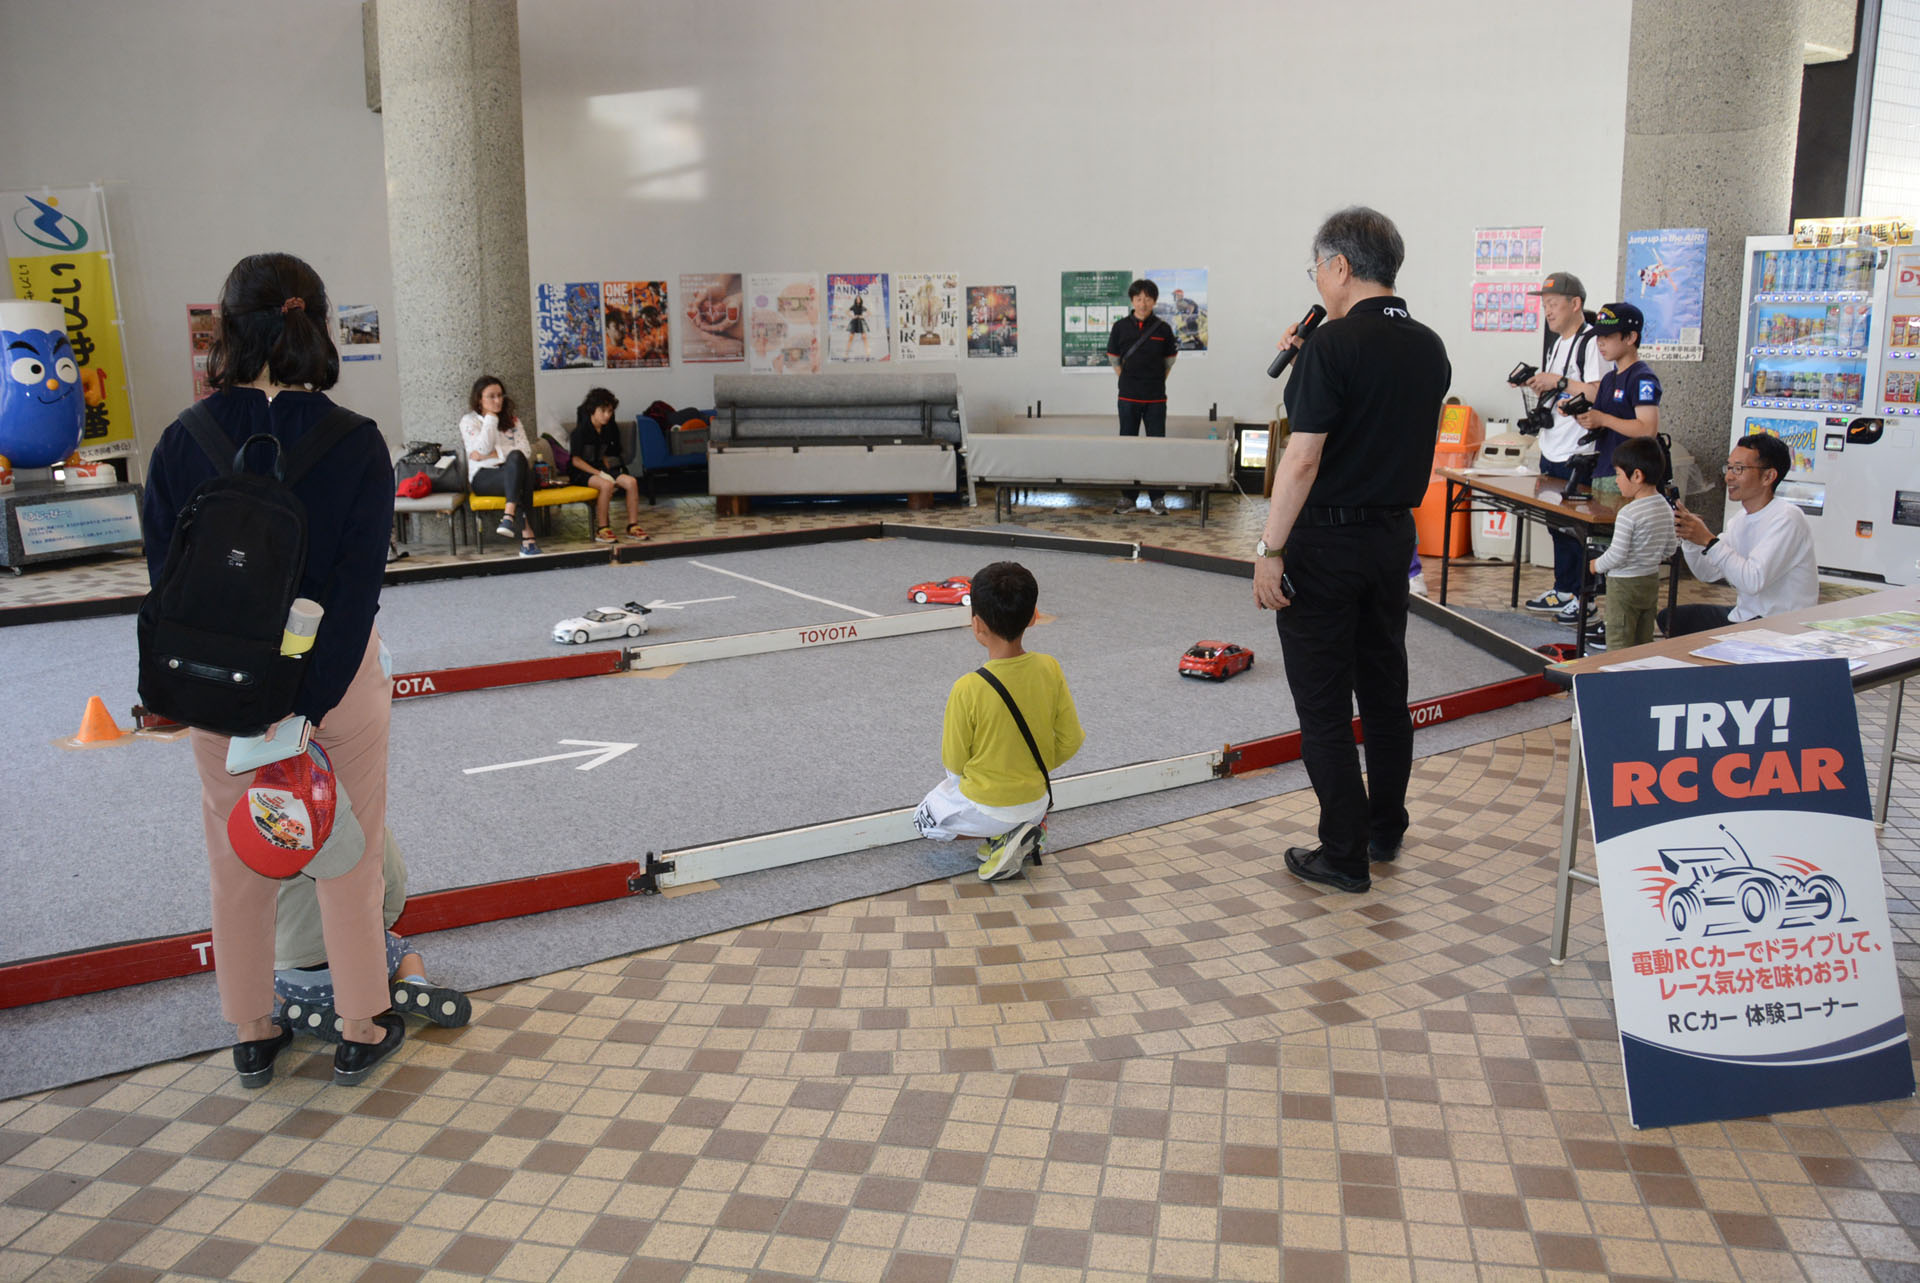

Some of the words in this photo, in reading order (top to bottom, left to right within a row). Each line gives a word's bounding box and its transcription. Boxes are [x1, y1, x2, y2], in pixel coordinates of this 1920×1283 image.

[606, 283, 628, 296] ONE
[799, 625, 857, 643] TOYOTA
[391, 676, 436, 695] OTA
[1410, 704, 1443, 727] YOTA
[1650, 697, 1791, 752] TRY!
[1612, 756, 1698, 807] RC
[1712, 747, 1846, 799] CAR
[1631, 930, 1883, 977] 電動RCカーでドライブして、
[1668, 1011, 1738, 1033] RCカー
[1745, 998, 1859, 1028] 体験コーナー
